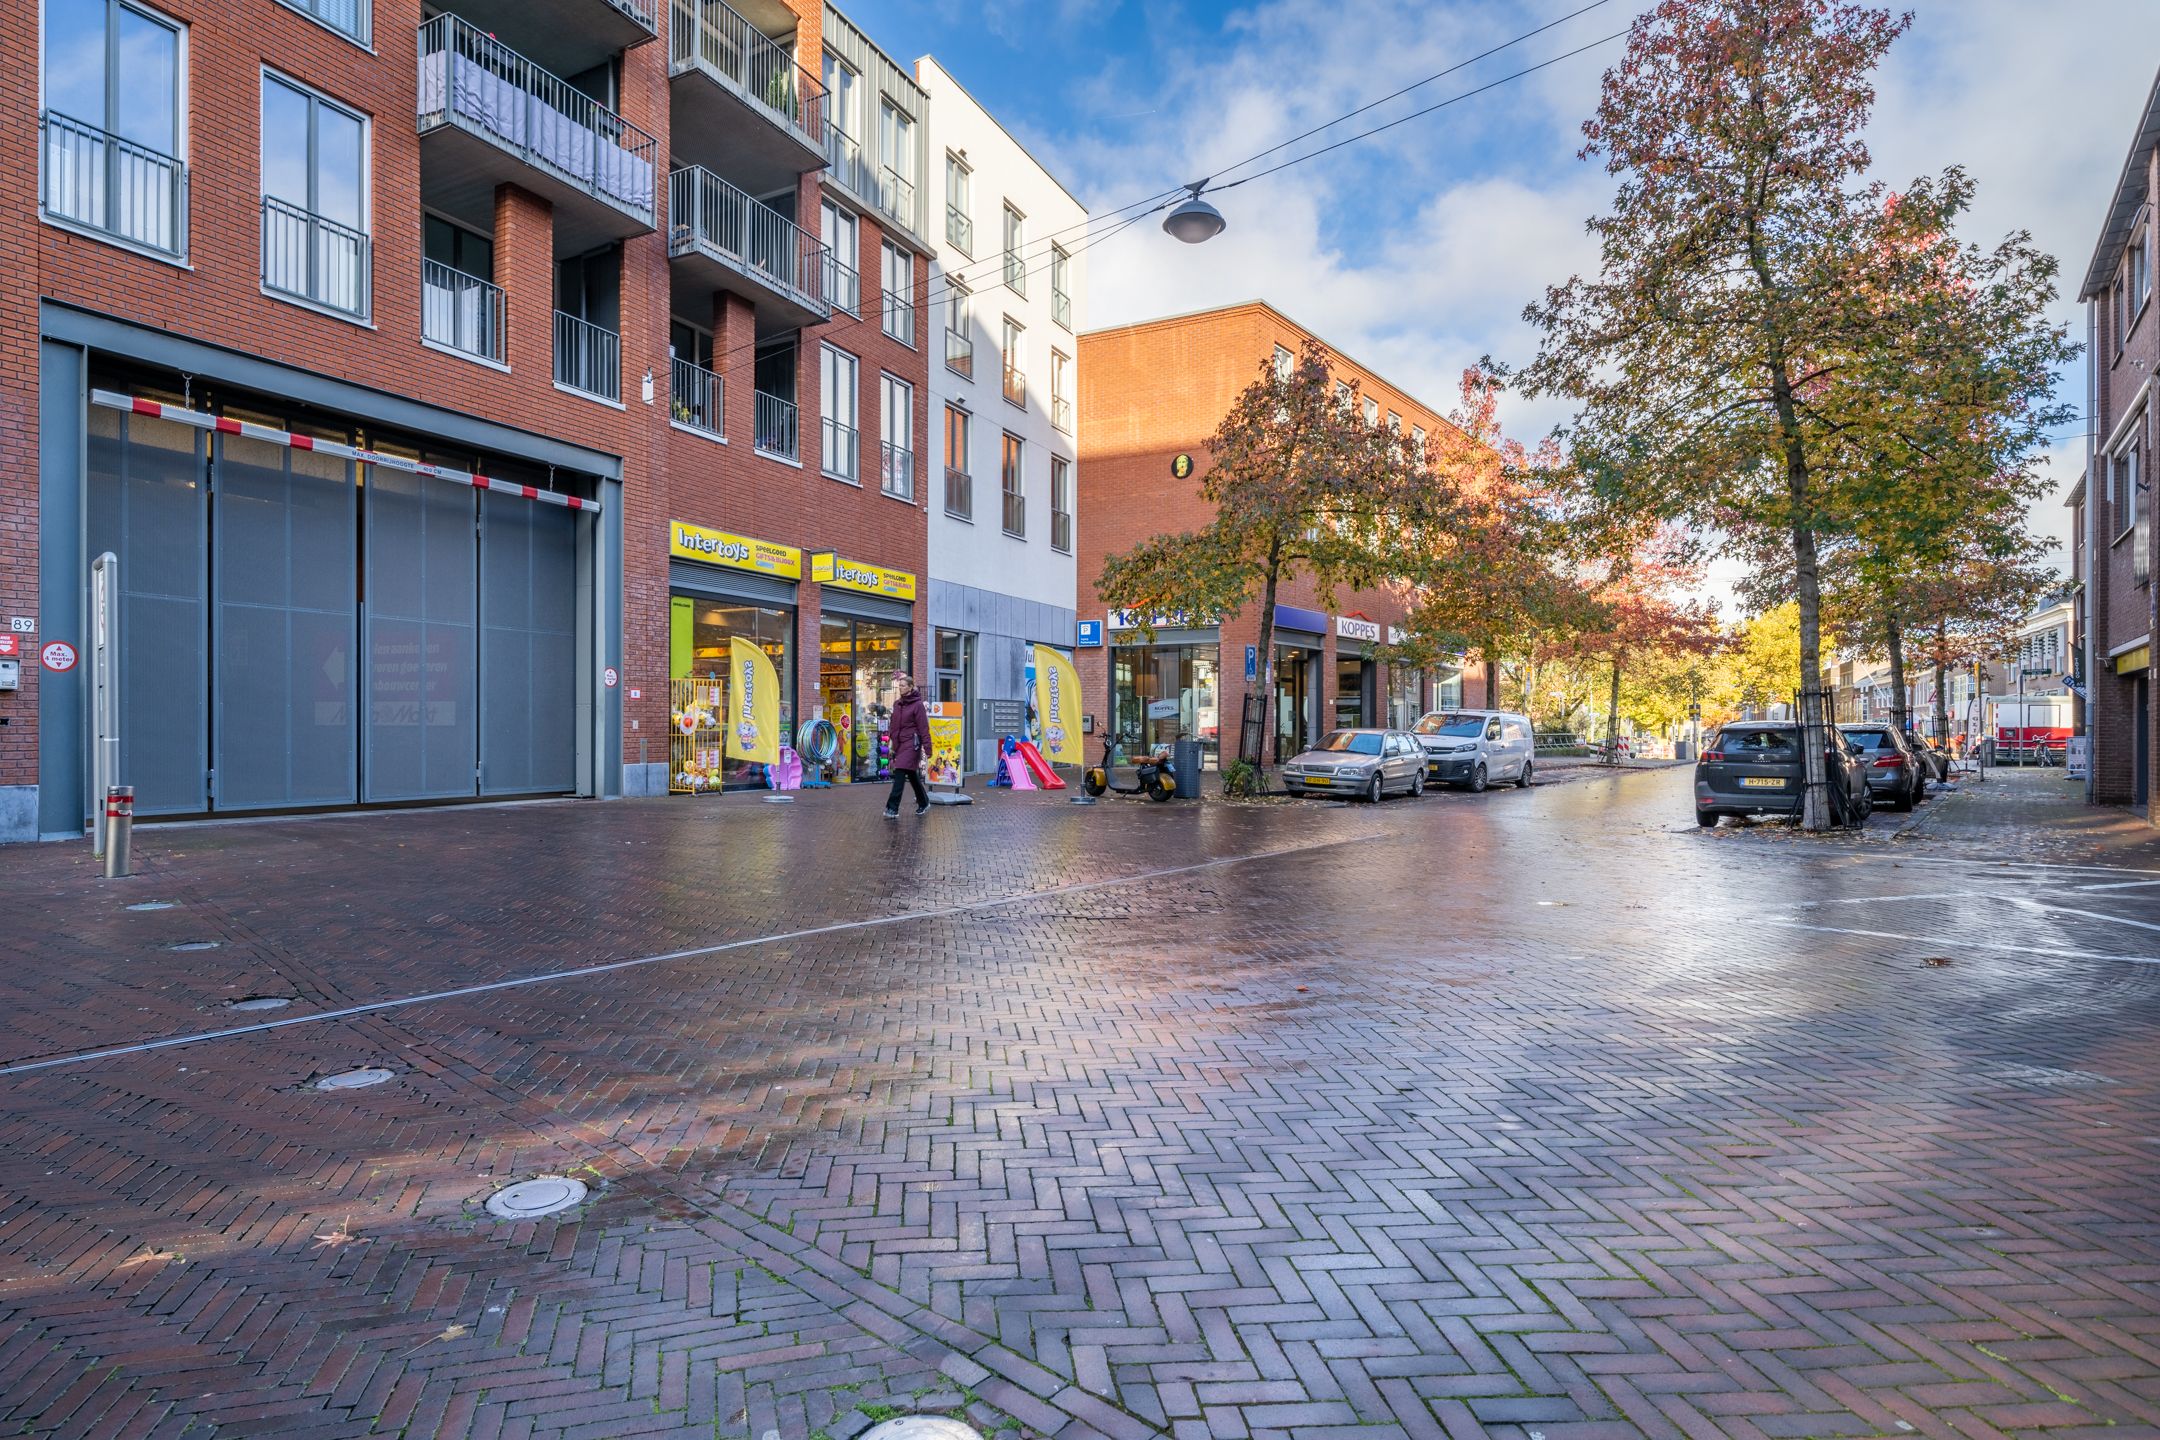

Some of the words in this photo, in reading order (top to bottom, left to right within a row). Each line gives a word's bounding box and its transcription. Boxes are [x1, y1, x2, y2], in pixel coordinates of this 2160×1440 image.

[678, 527, 750, 562] Intertoys
[13, 619, 33, 630] 89
[1341, 620, 1375, 639] KOPPES
[1248, 648, 1254, 664] P
[1748, 777, 1781, 785] H-715-ZR
